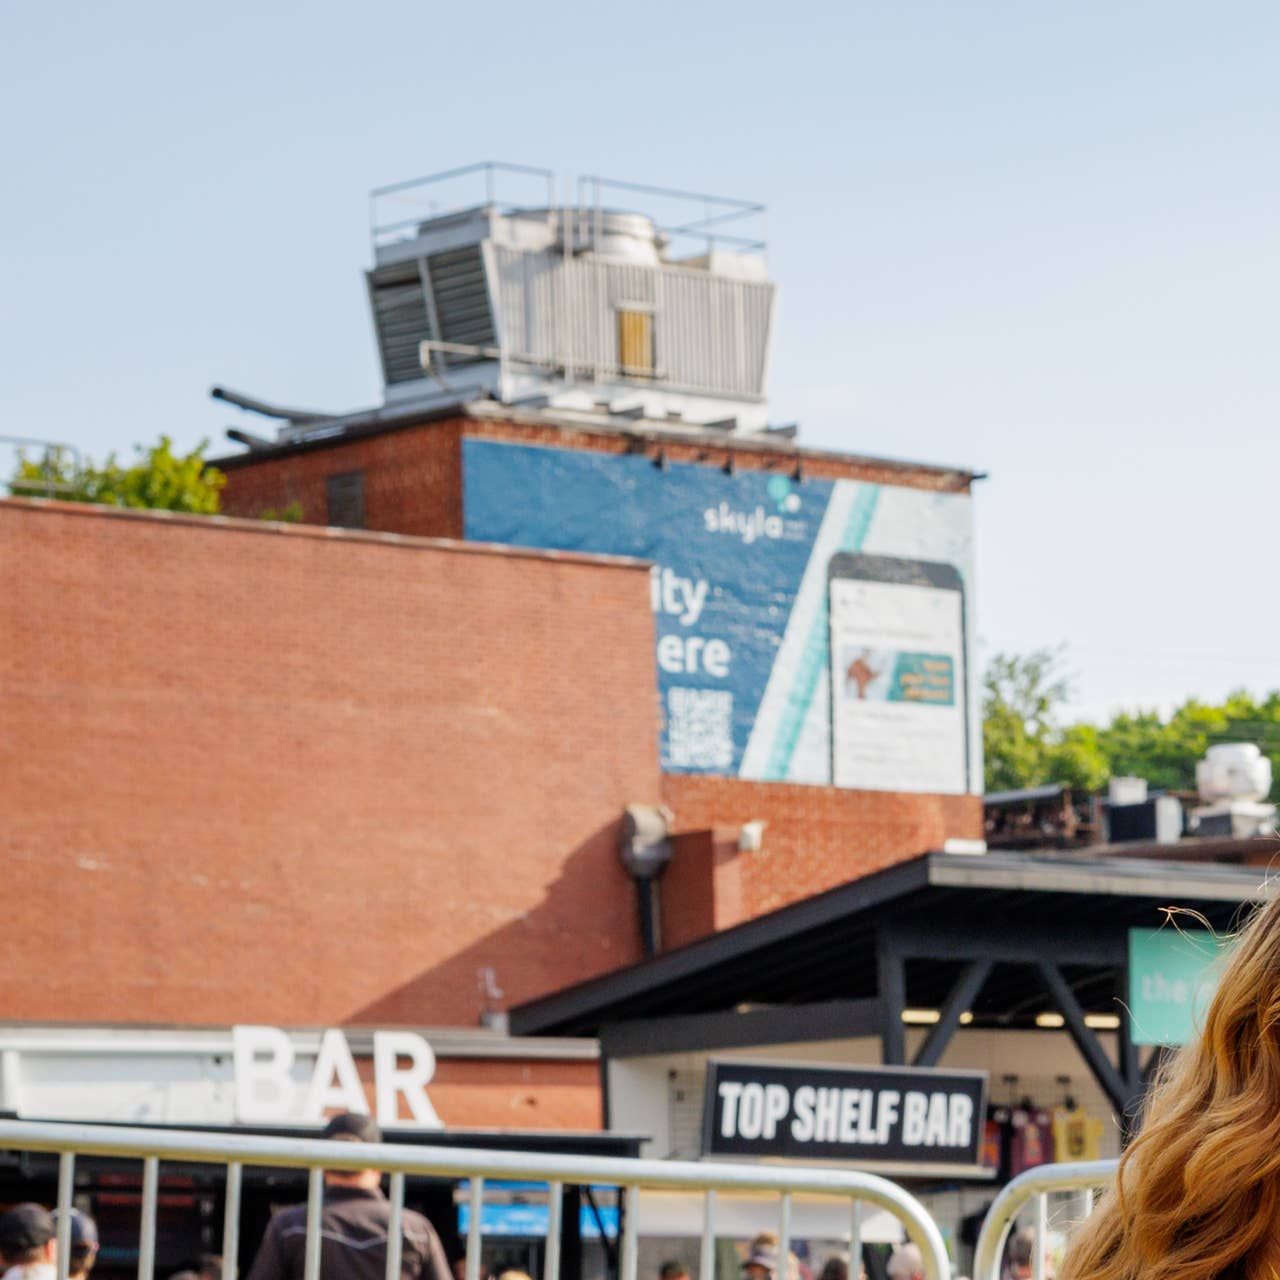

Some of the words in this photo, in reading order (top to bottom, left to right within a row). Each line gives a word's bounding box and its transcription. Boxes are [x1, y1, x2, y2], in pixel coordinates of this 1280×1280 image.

[704, 501, 783, 544] skyla
[650, 566, 708, 626] ity
[657, 634, 731, 678] ere
[233, 1024, 445, 1130] BAR
[718, 1081, 790, 1140] TOP
[791, 1085, 901, 1145] SHELF
[902, 1091, 973, 1148] BAR
